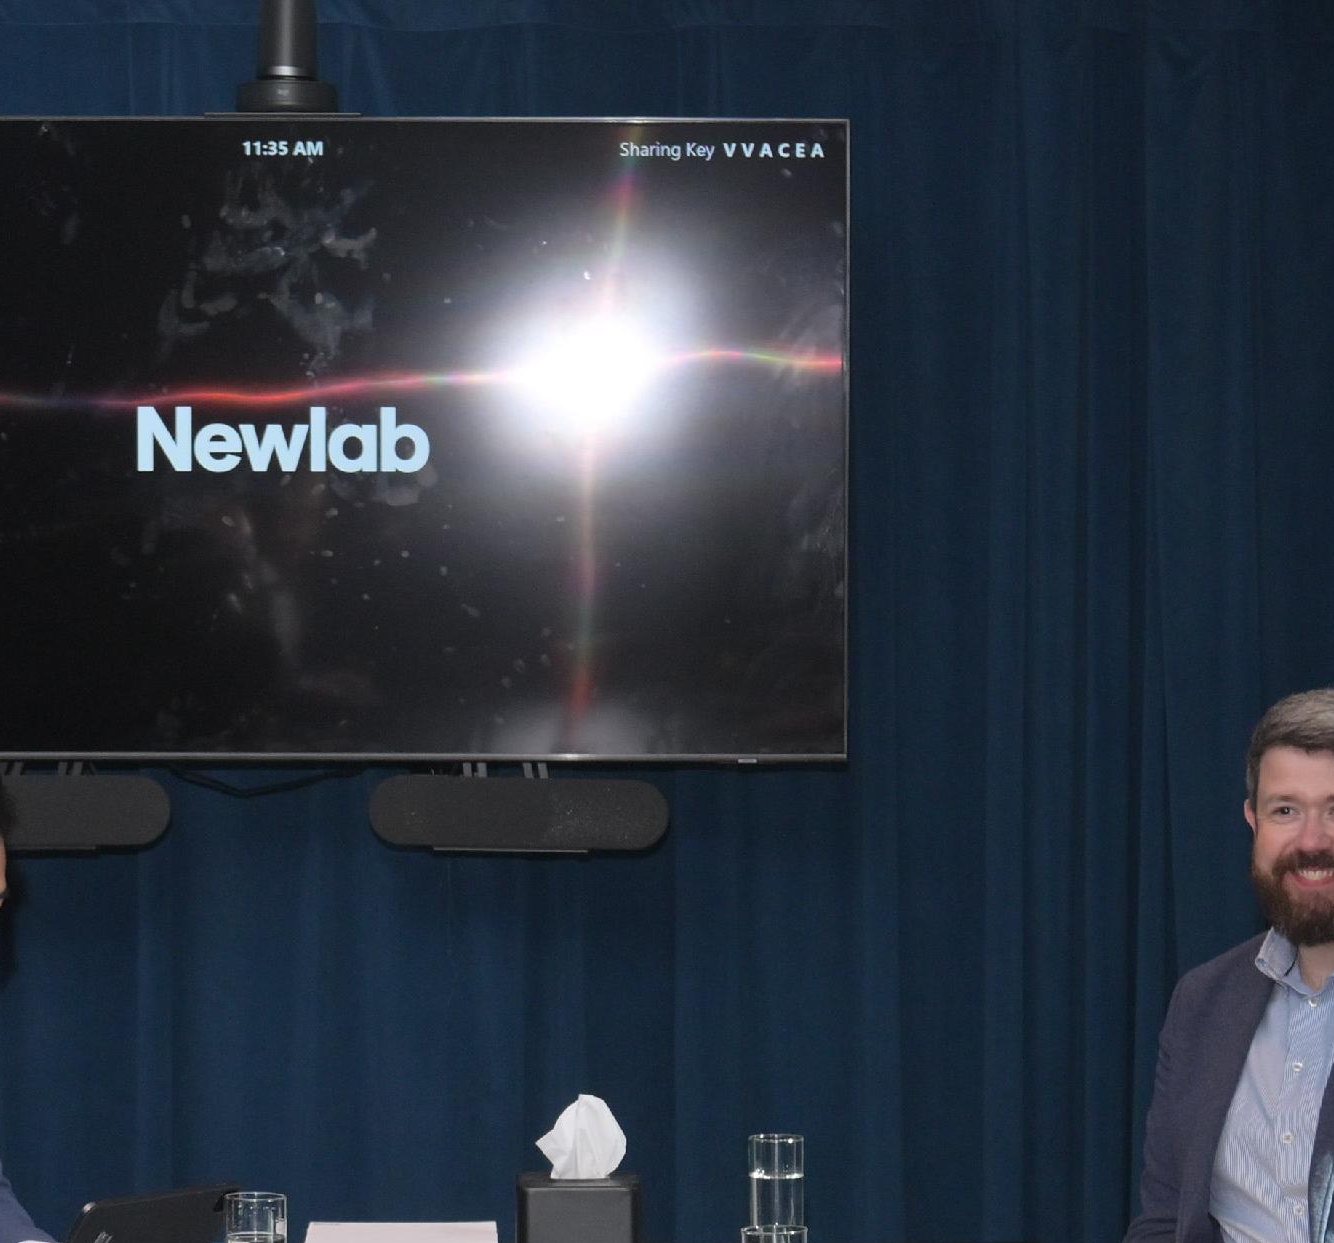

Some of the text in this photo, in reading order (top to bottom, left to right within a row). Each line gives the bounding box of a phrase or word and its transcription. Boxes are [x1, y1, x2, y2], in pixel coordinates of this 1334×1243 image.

[242, 140, 324, 156] 11:35 AM
[619, 141, 826, 161] Sharing Key VVACEA
[136, 406, 431, 474] Newlab
